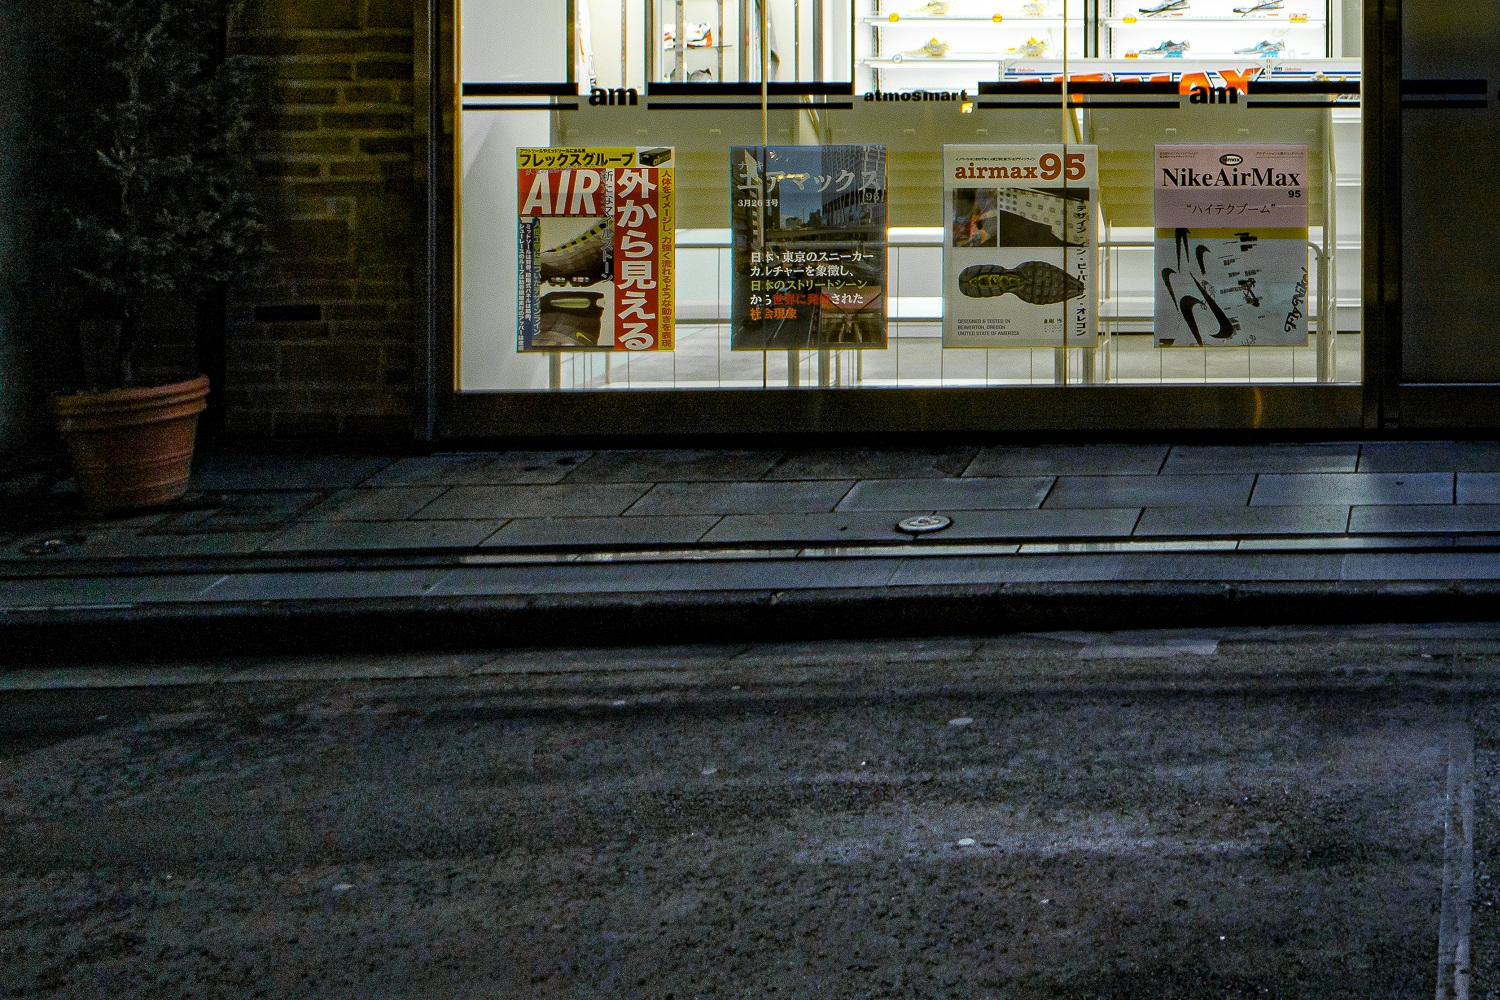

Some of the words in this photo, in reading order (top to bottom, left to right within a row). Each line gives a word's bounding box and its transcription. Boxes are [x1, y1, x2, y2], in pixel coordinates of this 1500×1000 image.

[588, 84, 639, 106] am
[863, 87, 968, 102] atmosmart
[1189, 82, 1239, 105] am
[519, 152, 636, 168] フレックスグルーブ
[737, 160, 764, 171] ナキ
[737, 169, 881, 193] エアマックス
[1161, 167, 1300, 187] NikeAirMax
[521, 169, 600, 215] AIR
[1288, 190, 1301, 198] 95
[616, 169, 657, 350] 外から見える
